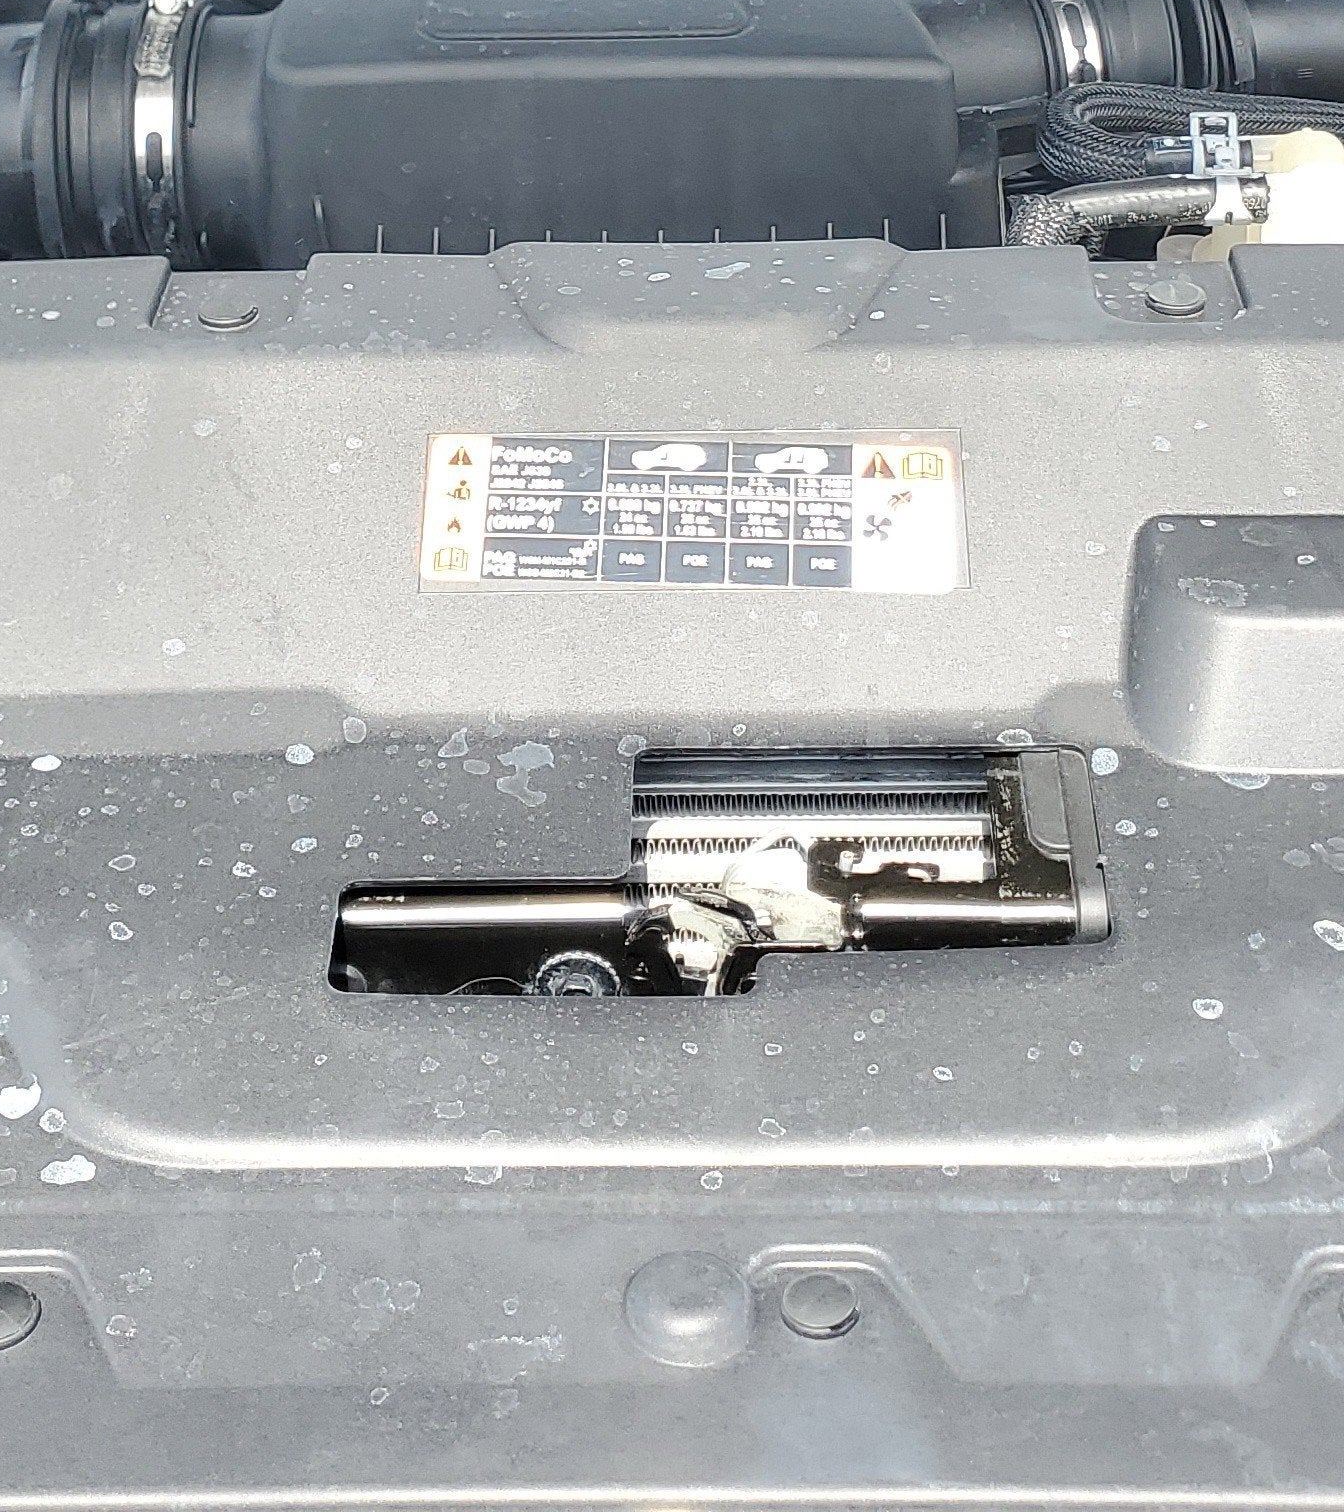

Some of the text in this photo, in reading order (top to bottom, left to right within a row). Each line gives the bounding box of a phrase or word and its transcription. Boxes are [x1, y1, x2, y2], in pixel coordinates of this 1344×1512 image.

[491, 445, 573, 464] FoMoCo
[487, 495, 563, 515] R-1234yf
[486, 514, 555, 533] (GWP 4)
[483, 550, 517, 564] PAG
[618, 552, 646, 566] PAG
[682, 554, 710, 567] POE
[745, 555, 775, 569] PAG
[810, 557, 839, 570] POE
[482, 563, 517, 577] POE
